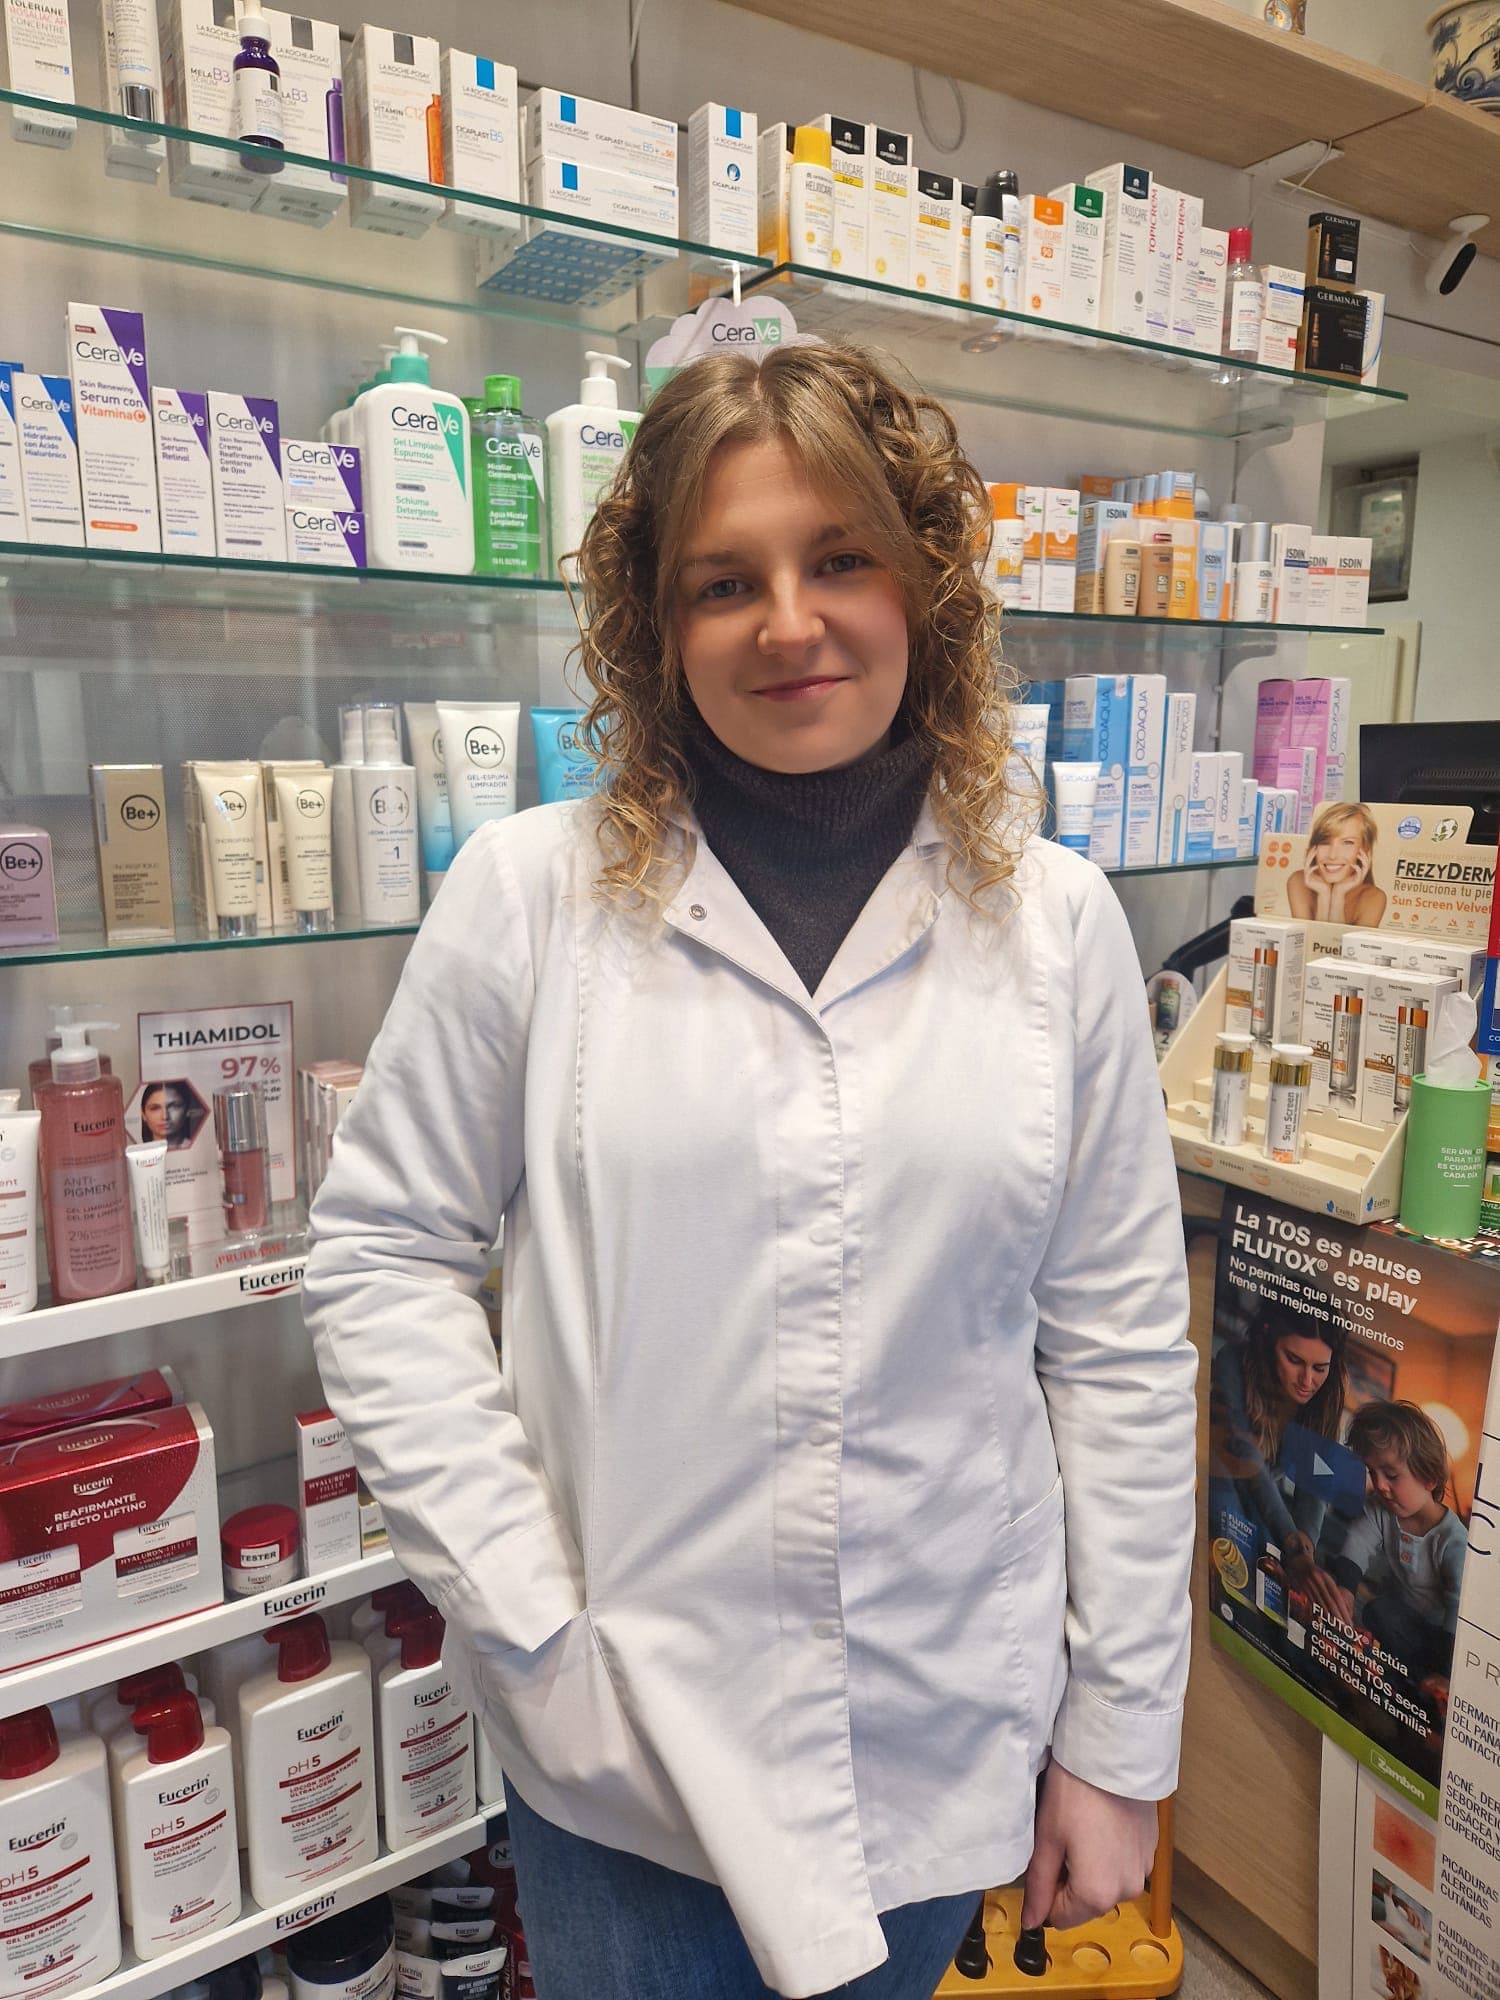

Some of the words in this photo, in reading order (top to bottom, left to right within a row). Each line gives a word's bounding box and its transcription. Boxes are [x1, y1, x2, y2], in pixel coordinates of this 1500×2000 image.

[213, 67, 231, 83] B3
[595, 134, 624, 146] CICAPLAST
[612, 203, 641, 215] CICAPLAST
[1325, 215, 1356, 228] GERMINAL
[1317, 291, 1361, 307] GERMINAL
[712, 321, 781, 343] CeraVe
[75, 340, 145, 367] CeraVe
[79, 379, 97, 389] Skin
[21, 396, 71, 412] CeraVe
[80, 391, 121, 406] Serum
[123, 397, 143, 408] con
[81, 405, 133, 420] Vitamina
[158, 409, 205, 426] CeraVe
[216, 412, 274, 434] CeraVe
[391, 406, 459, 436] CeraVe
[161, 442, 189, 453] Serum
[162, 452, 190, 462] Retinol
[287, 444, 355, 469] CeraVe
[394, 448, 434, 461] Espumoso
[485, 437, 541, 458] CeraVe
[396, 495, 430, 508] Schiuma
[292, 511, 360, 534] CeraVe
[1106, 508, 1127, 518] ISDIN
[1286, 548, 1306, 559] ISDIN
[1339, 557, 1362, 568] ISDIN
[1101, 689, 1113, 762] OZOAQUA
[1135, 690, 1147, 761] OZOAQUA
[469, 740, 501, 755] Be+
[300, 799, 322, 811] Be+
[1221, 768, 1230, 822] OZOAQUA
[126, 806, 157, 820] Be+
[5, 856, 39, 869] Be+
[1396, 859, 1496, 883] FREZYDERM
[1394, 880, 1456, 897] Revoluciona
[1461, 885, 1472, 897] tu
[1475, 887, 1492, 901] pie
[1392, 896, 1412, 906] Sun
[1416, 897, 1453, 911] Screen
[1313, 943, 1342, 956] Prue
[153, 1024, 280, 1048] THIAMIDOL
[1404, 1028, 1413, 1050] Screen
[220, 1056, 281, 1079] 97%
[1380, 1053, 1394, 1065] 50
[1284, 1091, 1295, 1122] Screen
[73, 1116, 115, 1133] Eucerin
[1282, 1124, 1291, 1141] Sun
[63, 1181, 116, 1198] PIGMENT
[1235, 1205, 1260, 1230] La
[1266, 1214, 1311, 1247] TOS
[1316, 1236, 1342, 1258] es
[1348, 1246, 1422, 1285] pause
[239, 1266, 303, 1293] Eucerin
[1230, 1255, 1247, 1272] No
[1248, 1265, 1301, 1293] permitas
[1303, 1284, 1328, 1305] que
[1330, 1293, 1342, 1310] la
[1345, 1299, 1375, 1321] TOS
[1333, 1270, 1360, 1292] es
[1366, 1282, 1418, 1316] play
[1228, 1271, 1257, 1293] frene
[1259, 1283, 1277, 1301] tus
[1280, 1293, 1330, 1323] mejores
[1332, 1315, 1405, 1351] momentos
[57, 1432, 114, 1452] Eucerin
[312, 1430, 346, 1446] Eucerin
[72, 1475, 113, 1495] Eucerin
[308, 1473, 351, 1490] HYALURON
[45, 1526, 54, 1535] Y
[56, 1513, 101, 1533] EFECTO
[103, 1500, 147, 1520] LIFTING
[54, 1493, 137, 1522] REAFIRMANTE
[137, 1519, 170, 1535] Eucerin
[1228, 1513, 1253, 1536] FLUTOX
[17, 1552, 52, 1567] Eucerin
[241, 1551, 277, 1562] TESTER
[263, 1585, 326, 1616] Eucerin
[1311, 1619, 1385, 1676] eficazmente
[1372, 1645, 1409, 1678] actúa
[1311, 1646, 1337, 1674] Para
[1339, 1667, 1367, 1694] toda
[1369, 1688, 1383, 1706] la
[1311, 1634, 1349, 1668] contra
[1350, 1659, 1363, 1678] la
[1364, 1670, 1393, 1698] TOS
[1394, 1692, 1432, 1724] seca.
[298, 1713, 344, 1742] Eucerin
[1452, 1711, 1471, 1732] DEL
[1377, 1757, 1425, 1800] Zambon
[1447, 1770, 1476, 1800] ACNÉ,
[158, 1777, 207, 1805] Eucerin
[1445, 1799, 1492, 1840] ROSÁCEA
[8, 1822, 66, 1850] Eucerin
[1442, 1854, 1499, 1903] PICADURAS
[1, 1897, 18, 1908] GEL
[20, 1893, 32, 1903] DE
[1441, 1870, 1489, 1911] ALERGIAS
[276, 1895, 337, 1930] Eucerin
[1440, 1883, 1492, 1929] CUTÁNEAS
[5, 1935, 21, 1945] GEL
[23, 1930, 36, 1941] DE
[39, 1917, 68, 1936] BANHO
[1439, 1920, 1489, 1966] CUIDADOS
[465, 1960, 491, 1971] Eucerin
[1438, 1934, 1484, 1977] PACIENTE
[1438, 1947, 1444, 1959] Y
[1446, 1955, 1467, 1978] CON
